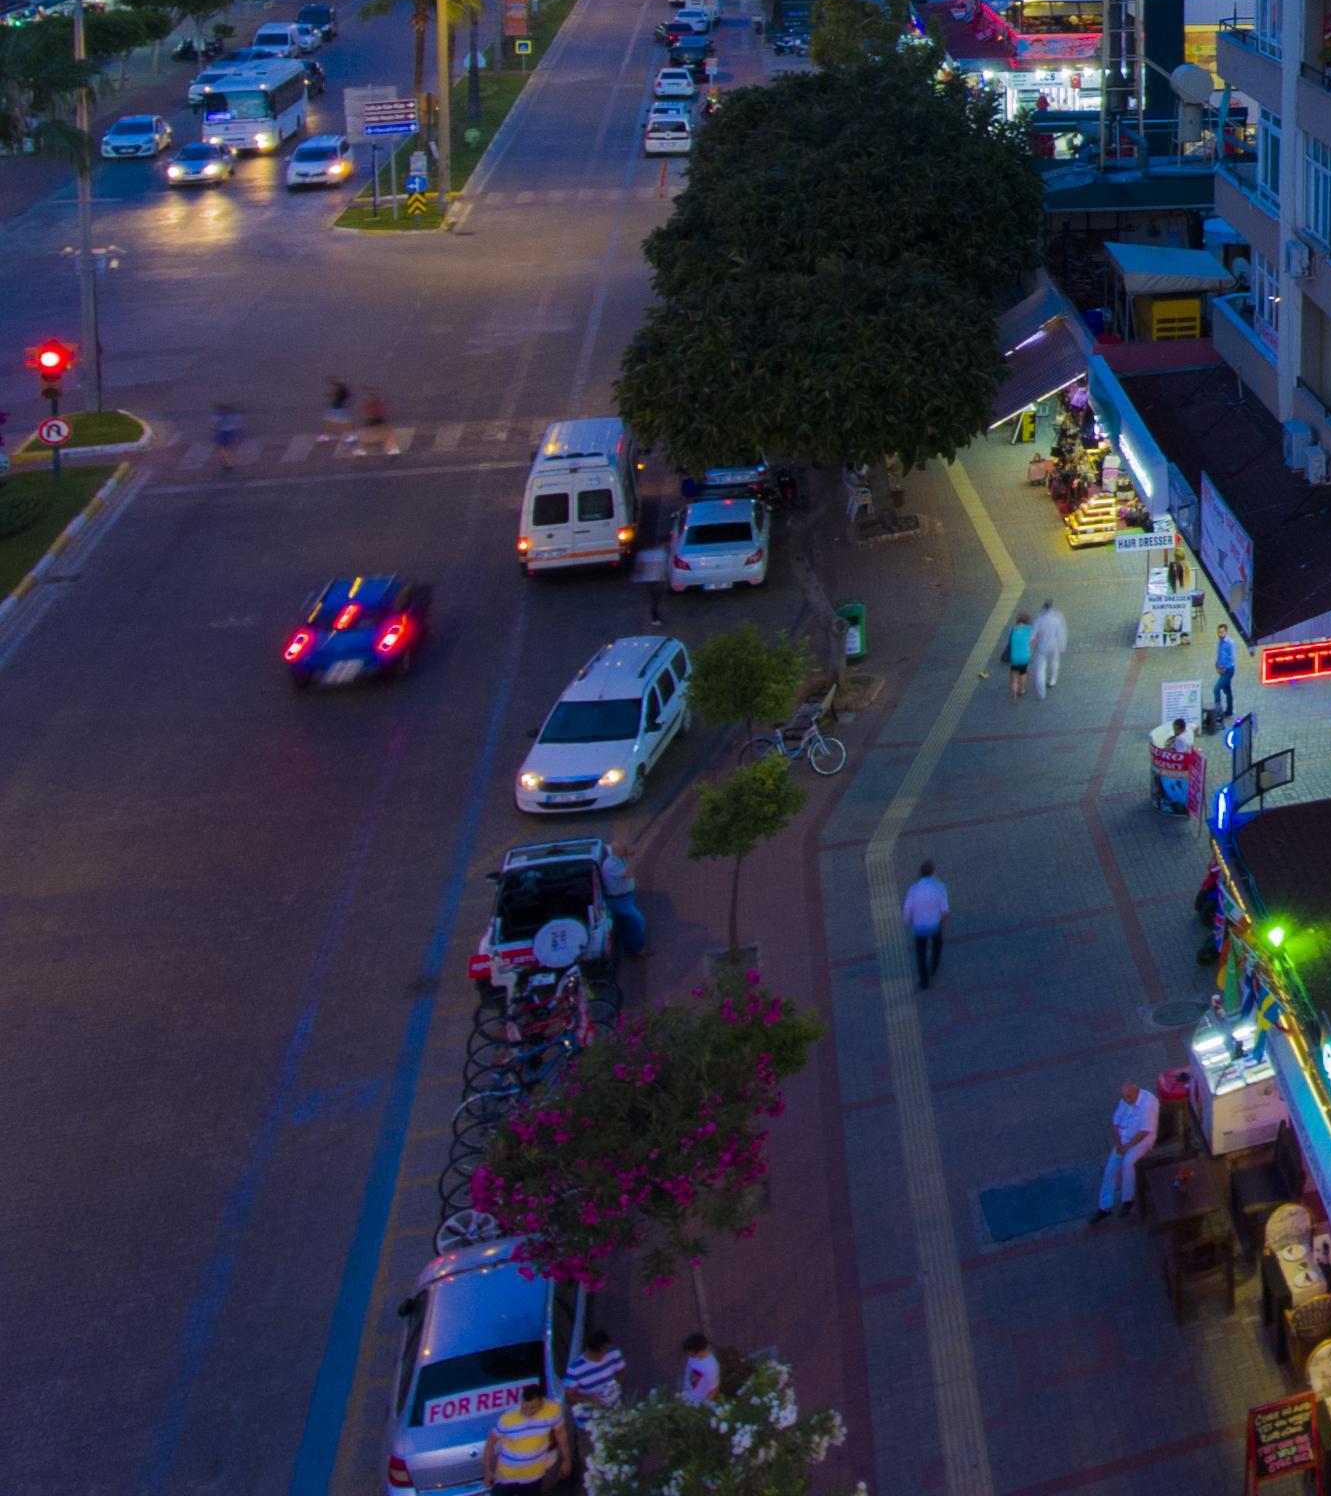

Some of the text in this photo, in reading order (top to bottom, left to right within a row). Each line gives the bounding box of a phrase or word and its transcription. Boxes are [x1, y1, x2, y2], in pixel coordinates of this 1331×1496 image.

[1117, 535, 1173, 550] HAIR DRESSER
[429, 1385, 524, 1423] FOR REN
